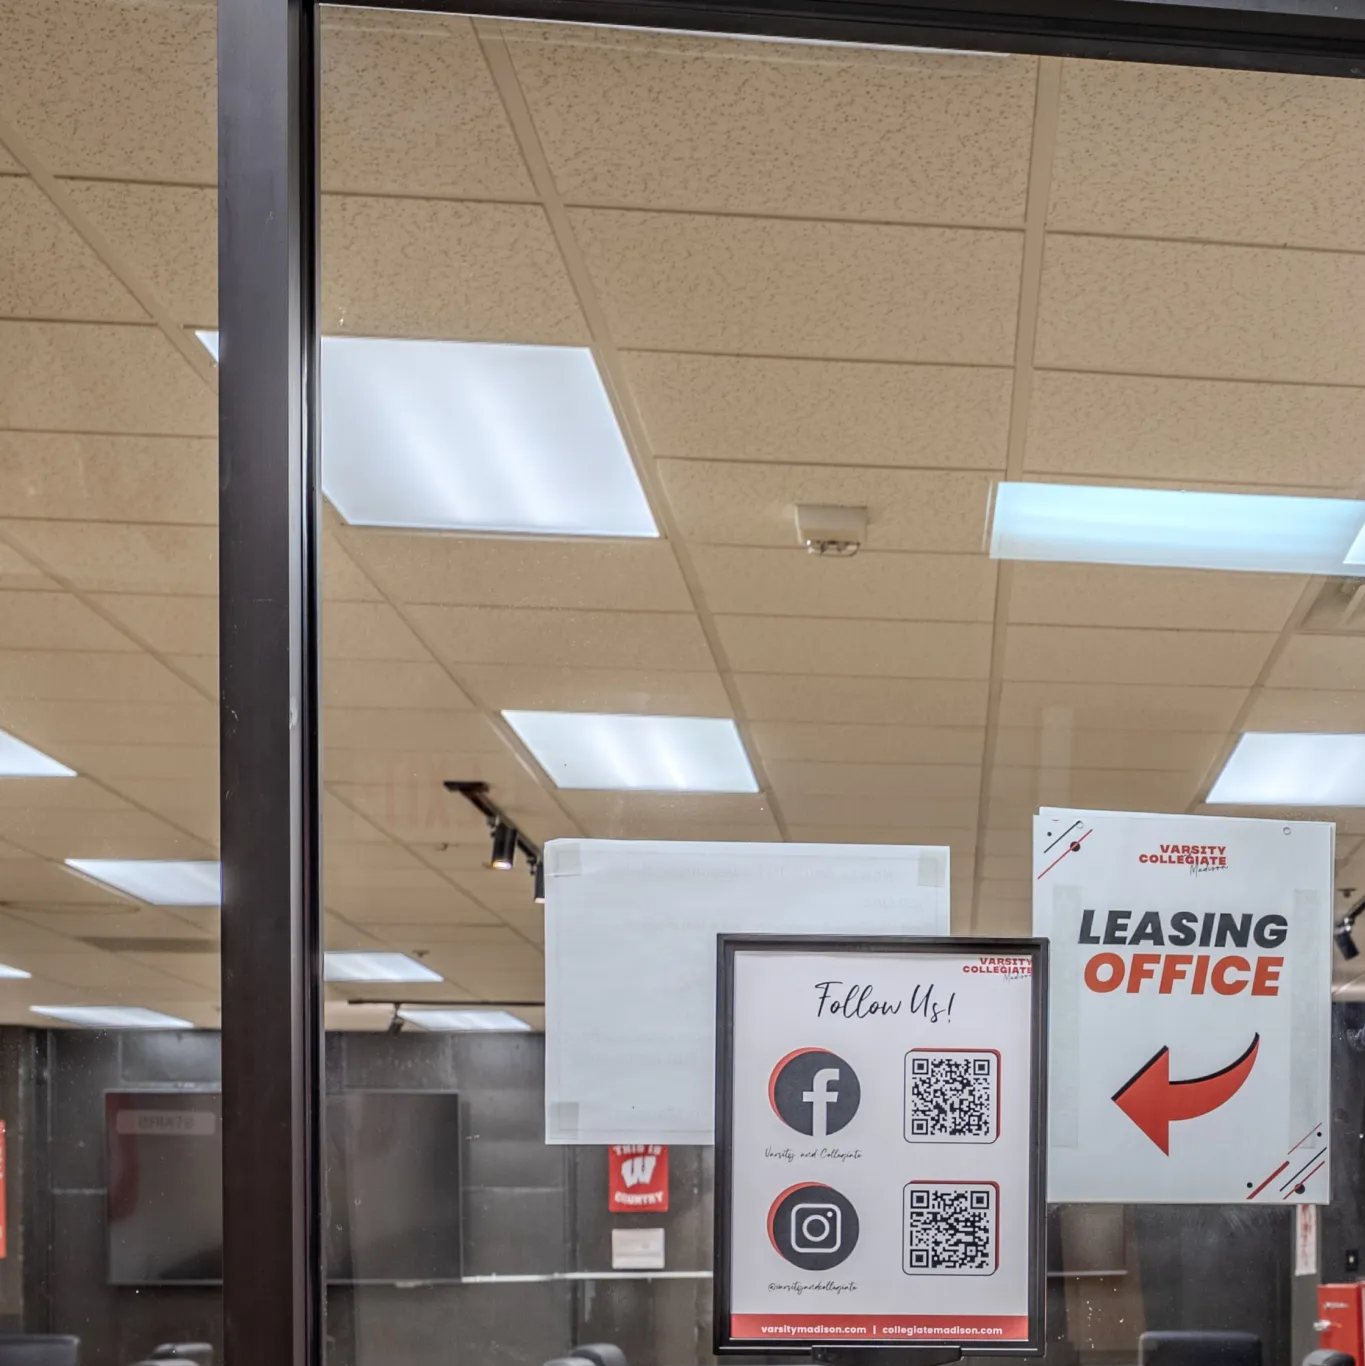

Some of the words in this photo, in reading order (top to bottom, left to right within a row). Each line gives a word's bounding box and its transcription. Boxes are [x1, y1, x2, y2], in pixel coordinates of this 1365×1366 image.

[1160, 844, 1226, 855] VARSITY
[1138, 854, 1227, 866] COLLEGIATE
[1078, 909, 1289, 949] LEASING
[980, 957, 1032, 966] VARSITY
[962, 965, 1032, 974] COLLEGIATE
[1084, 952, 1285, 996] OFFICE
[815, 981, 902, 1018] Follow
[909, 984, 956, 1023] Us!
[765, 1146, 796, 1162] Varsity
[800, 1148, 818, 1159] and
[820, 1147, 863, 1162] Collegiate
[761, 1325, 867, 1335] varsitymadison.com
[882, 1326, 1003, 1336] collegiatemadison.com
